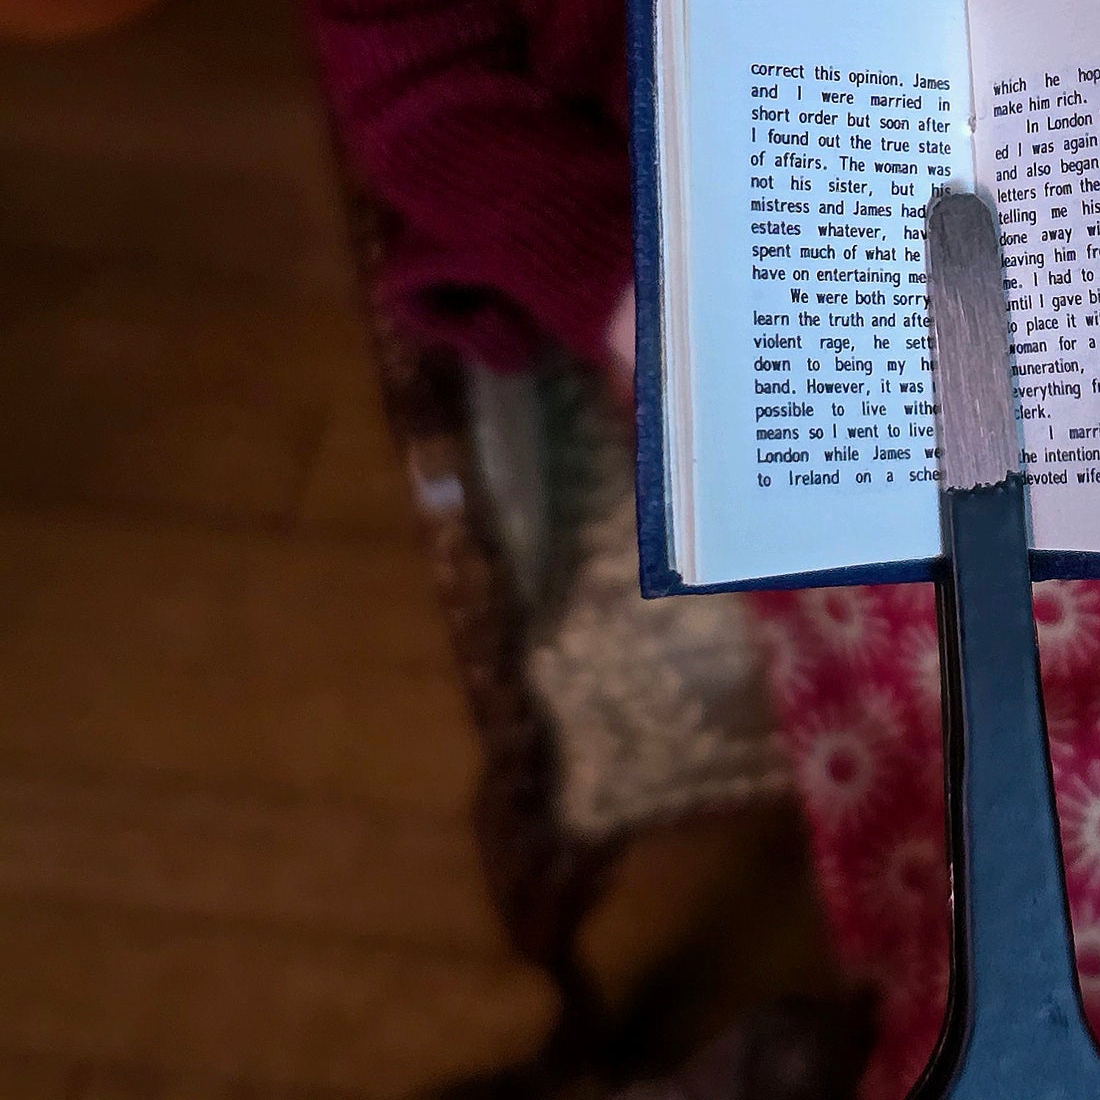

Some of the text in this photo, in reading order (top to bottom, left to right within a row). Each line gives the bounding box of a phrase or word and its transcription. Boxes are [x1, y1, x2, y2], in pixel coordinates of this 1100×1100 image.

[751, 64, 951, 90] correct this opinion. James
[993, 77, 1027, 96] which
[1045, 73, 1060, 88] he
[751, 84, 950, 111] and I were married in
[993, 90, 1088, 117] make him rich.
[751, 107, 951, 133] short order but soon after
[1026, 119, 1039, 134] In
[1047, 112, 1093, 131] London
[751, 127, 952, 155] I found out the true state
[995, 144, 1009, 160] ed
[1018, 142, 1022, 157] I
[1032, 141, 1055, 155] was
[1063, 132, 1098, 155] again
[750, 151, 952, 177] of affairs. The woman was
[996, 165, 1017, 182] and
[1026, 161, 1051, 178] also
[1060, 158, 1099, 176] began
[750, 175, 915, 197] not his sister, but
[997, 188, 1037, 203] letters
[1044, 181, 1073, 197] from
[1079, 177, 1100, 193] the
[750, 196, 926, 219] mistress and James had
[1051, 206, 1068, 219] me
[750, 220, 887, 241] estates whatever,
[1041, 228, 1073, 244] away
[751, 244, 921, 262] spent much of what he
[1054, 246, 1077, 263] him
[752, 264, 901, 288] have on entertaining
[1034, 272, 1038, 287] I
[1048, 268, 1072, 286] had
[1081, 268, 1094, 282] to
[790, 288, 886, 305] We were both
[1039, 294, 1044, 308] I
[1052, 294, 1082, 312] gave
[753, 311, 896, 328] learn the truth and
[1026, 316, 1059, 336] place
[1066, 313, 1077, 329] it
[753, 333, 890, 354] violent rage, he
[1059, 335, 1077, 351] for
[1088, 337, 1096, 349] a
[753, 355, 906, 376] down to being my
[754, 378, 797, 395] band.
[806, 378, 871, 396] However,
[881, 378, 891, 394] it
[899, 382, 924, 394] was
[755, 400, 887, 423] possible to live
[756, 422, 934, 441] means so I went to live
[1049, 425, 1054, 440] I
[756, 445, 911, 464] London while James
[1044, 446, 1100, 463] intention
[757, 469, 894, 487] to Ireland on a
